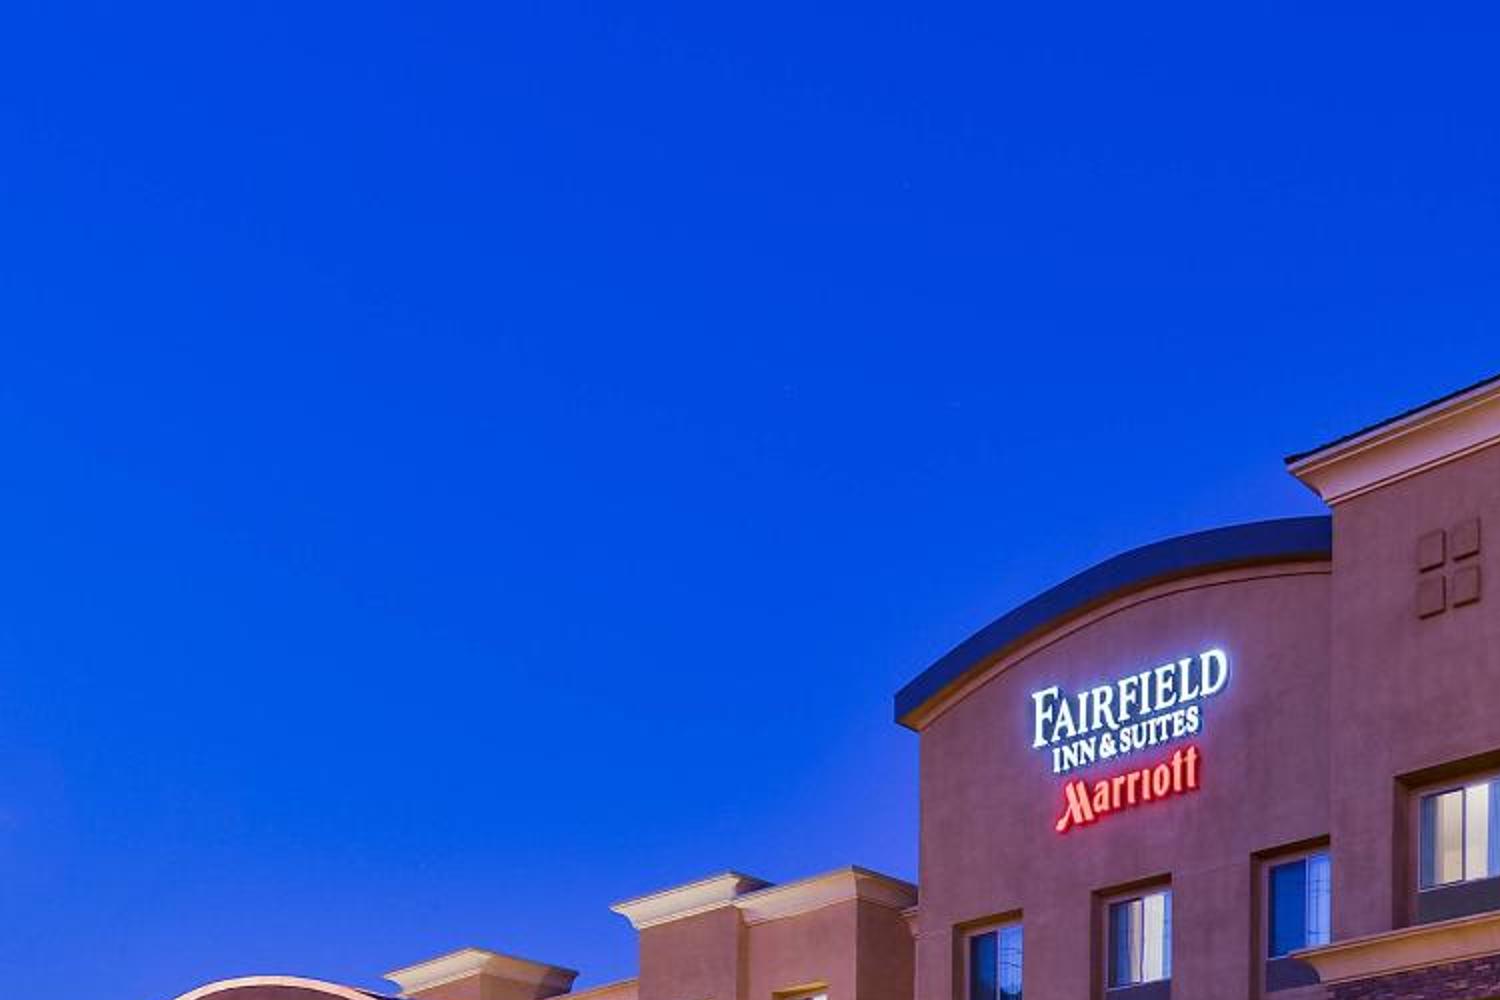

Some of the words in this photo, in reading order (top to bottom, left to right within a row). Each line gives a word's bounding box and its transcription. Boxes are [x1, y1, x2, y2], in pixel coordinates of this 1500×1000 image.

[1031, 648, 1227, 748] FAIRFIELD
[1053, 735, 1097, 773] INN
[1099, 729, 1118, 759] &
[1120, 705, 1200, 752] SUITES
[1055, 745, 1198, 832] Marriott
